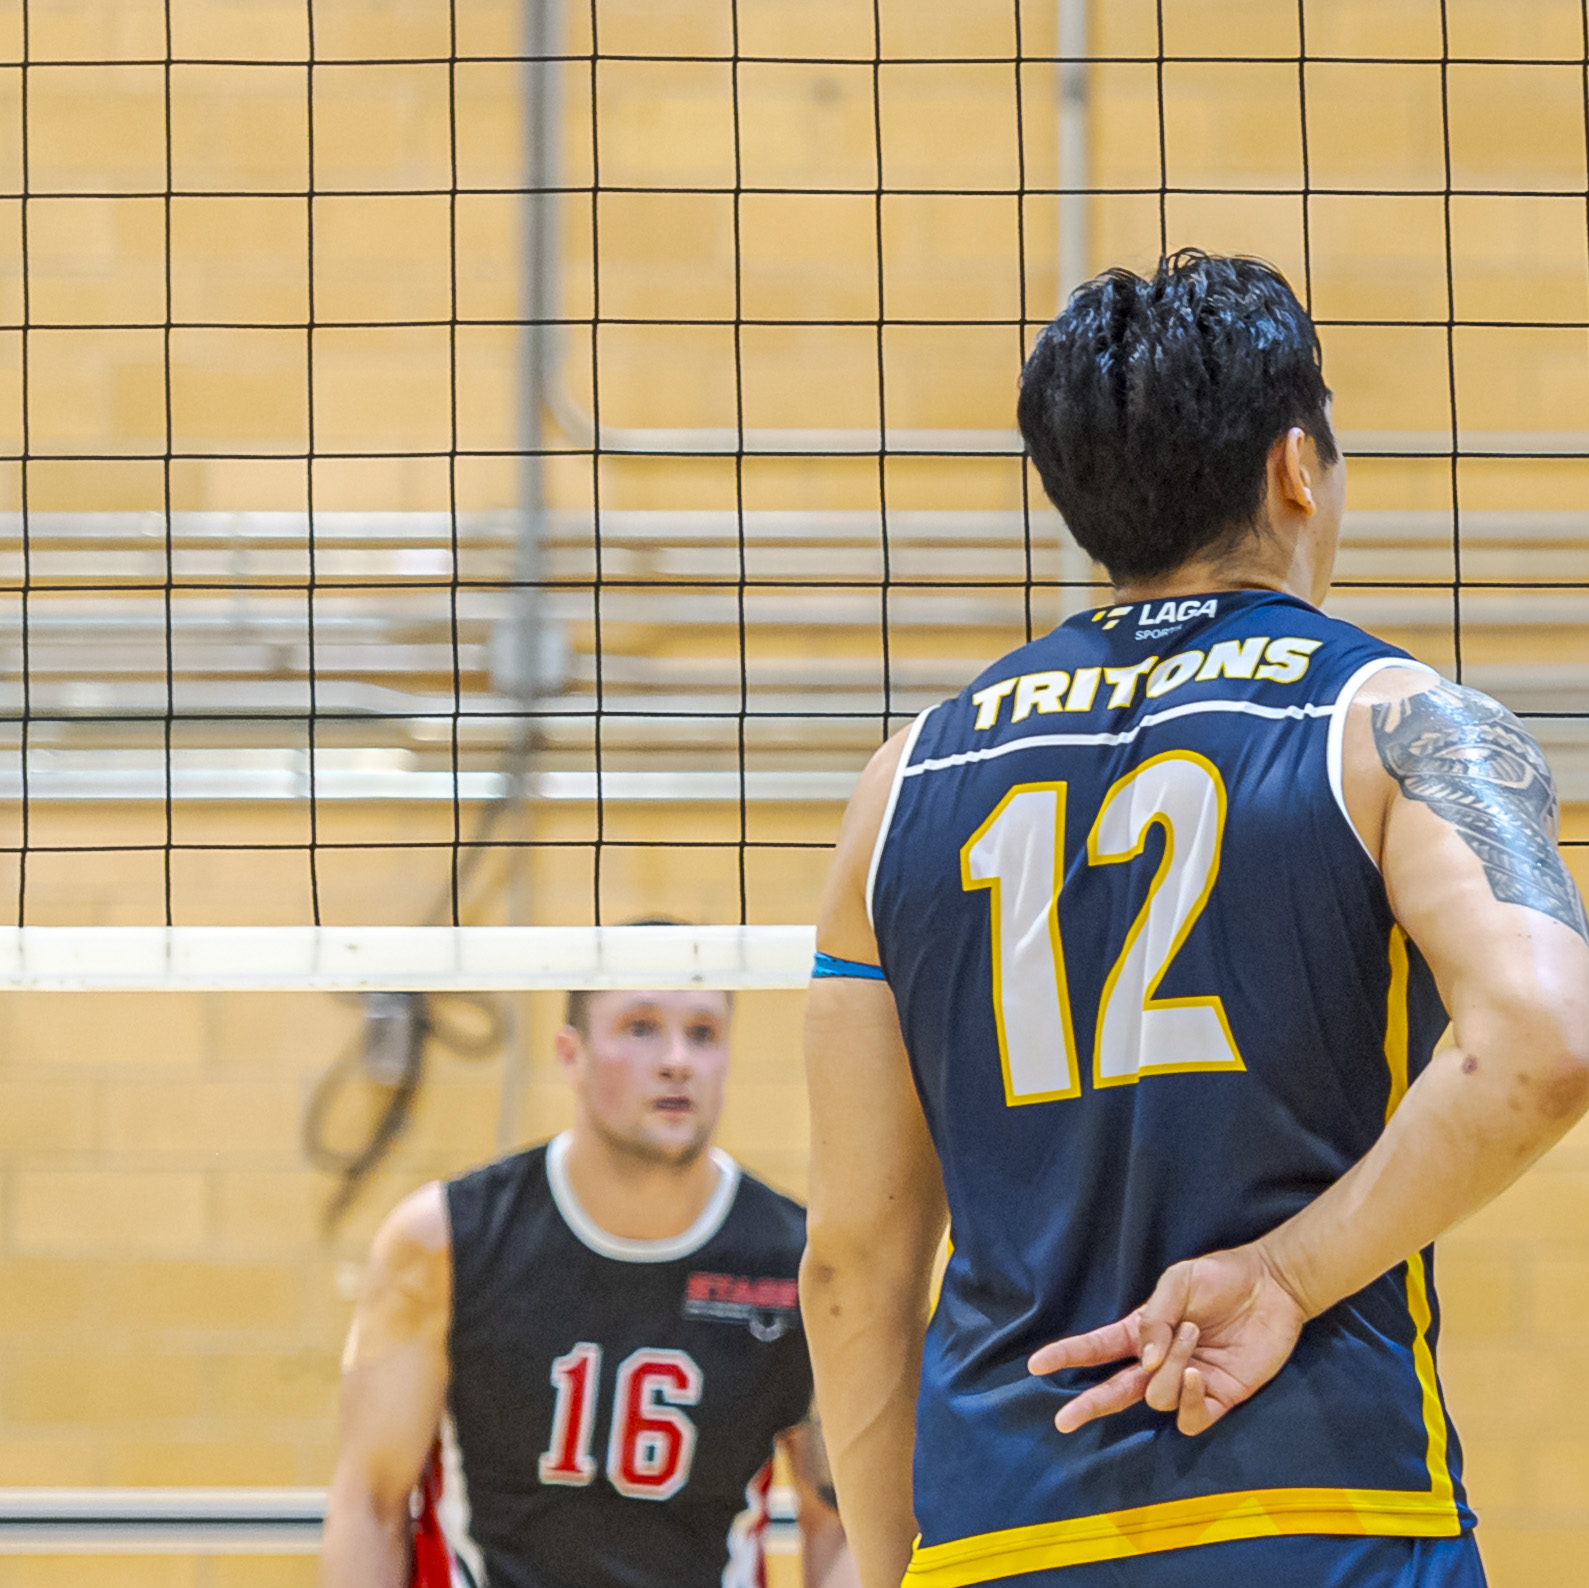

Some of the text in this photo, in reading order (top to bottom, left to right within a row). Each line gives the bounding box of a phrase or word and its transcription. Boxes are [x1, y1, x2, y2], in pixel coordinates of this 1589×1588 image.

[1138, 599, 1218, 625] LAGA
[970, 636, 1323, 731] TRITONS
[960, 749, 1248, 1107] 12
[538, 1341, 704, 1502] 16
